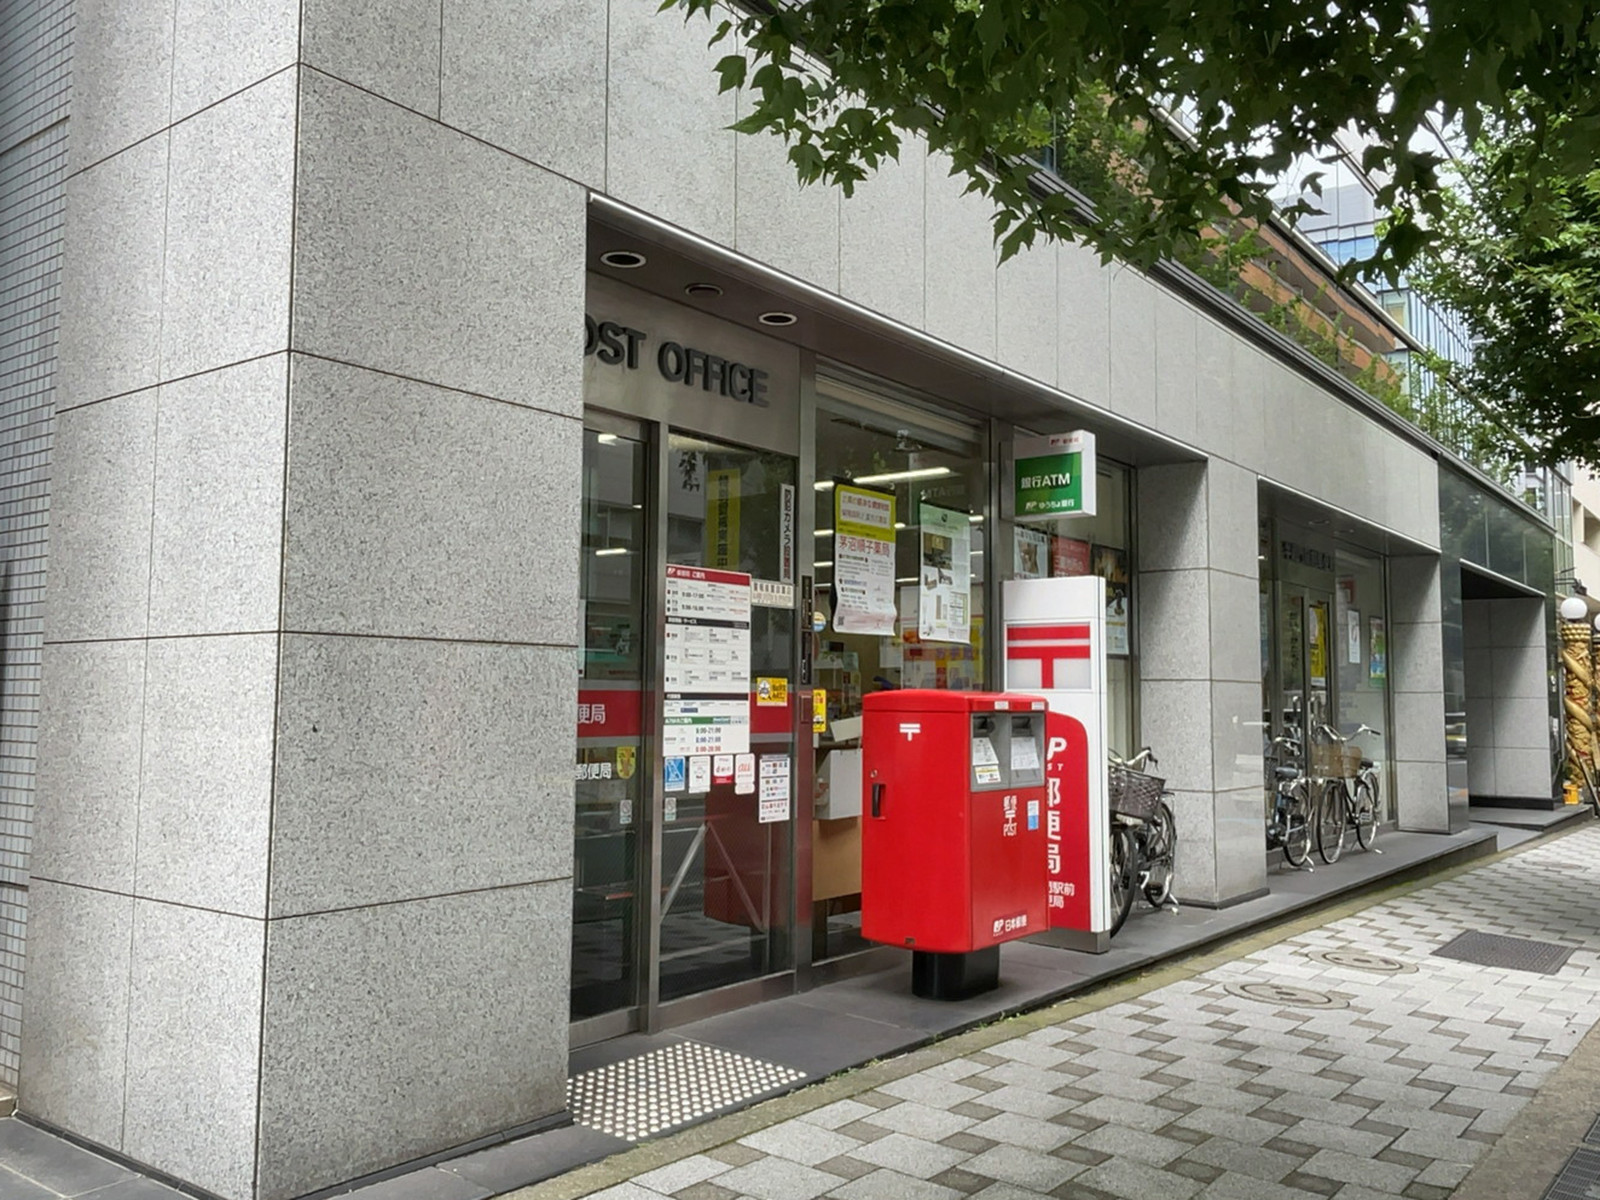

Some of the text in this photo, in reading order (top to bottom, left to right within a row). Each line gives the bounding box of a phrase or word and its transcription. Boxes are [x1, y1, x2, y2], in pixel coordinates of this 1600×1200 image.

[657, 341, 768, 407] OFFICE
[1021, 473, 1071, 489] 銀行ATM
[1039, 499, 1075, 510] ゆうちょ銀行
[575, 762, 612, 780] 郵便局
[1003, 822, 1018, 837] POST
[1005, 916, 1028, 932] 日本郵便
